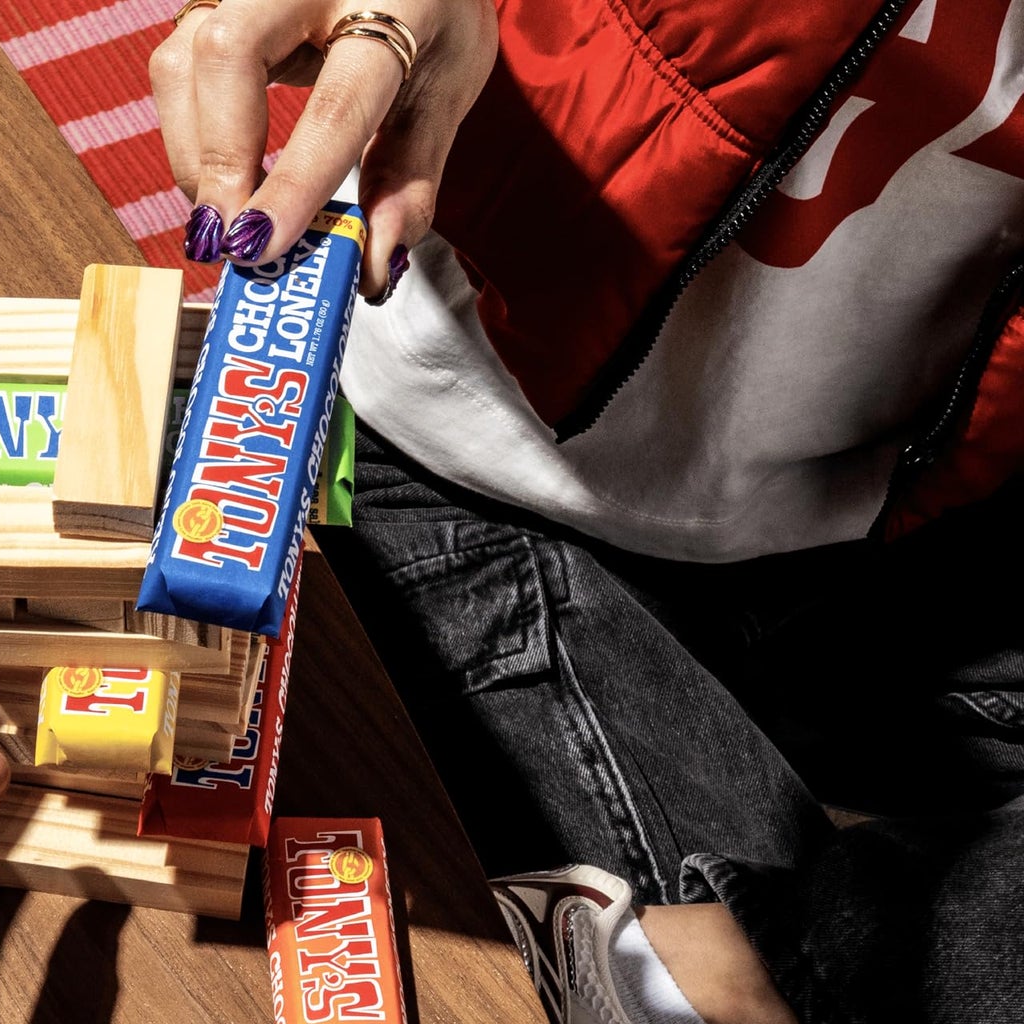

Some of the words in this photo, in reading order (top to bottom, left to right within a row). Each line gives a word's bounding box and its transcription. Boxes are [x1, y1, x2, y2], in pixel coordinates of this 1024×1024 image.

[323, 215, 353, 230] 70%
[170, 353, 310, 572] TONY'S
[277, 486, 312, 601] TONY'S
[284, 829, 387, 1024] TONY'S
